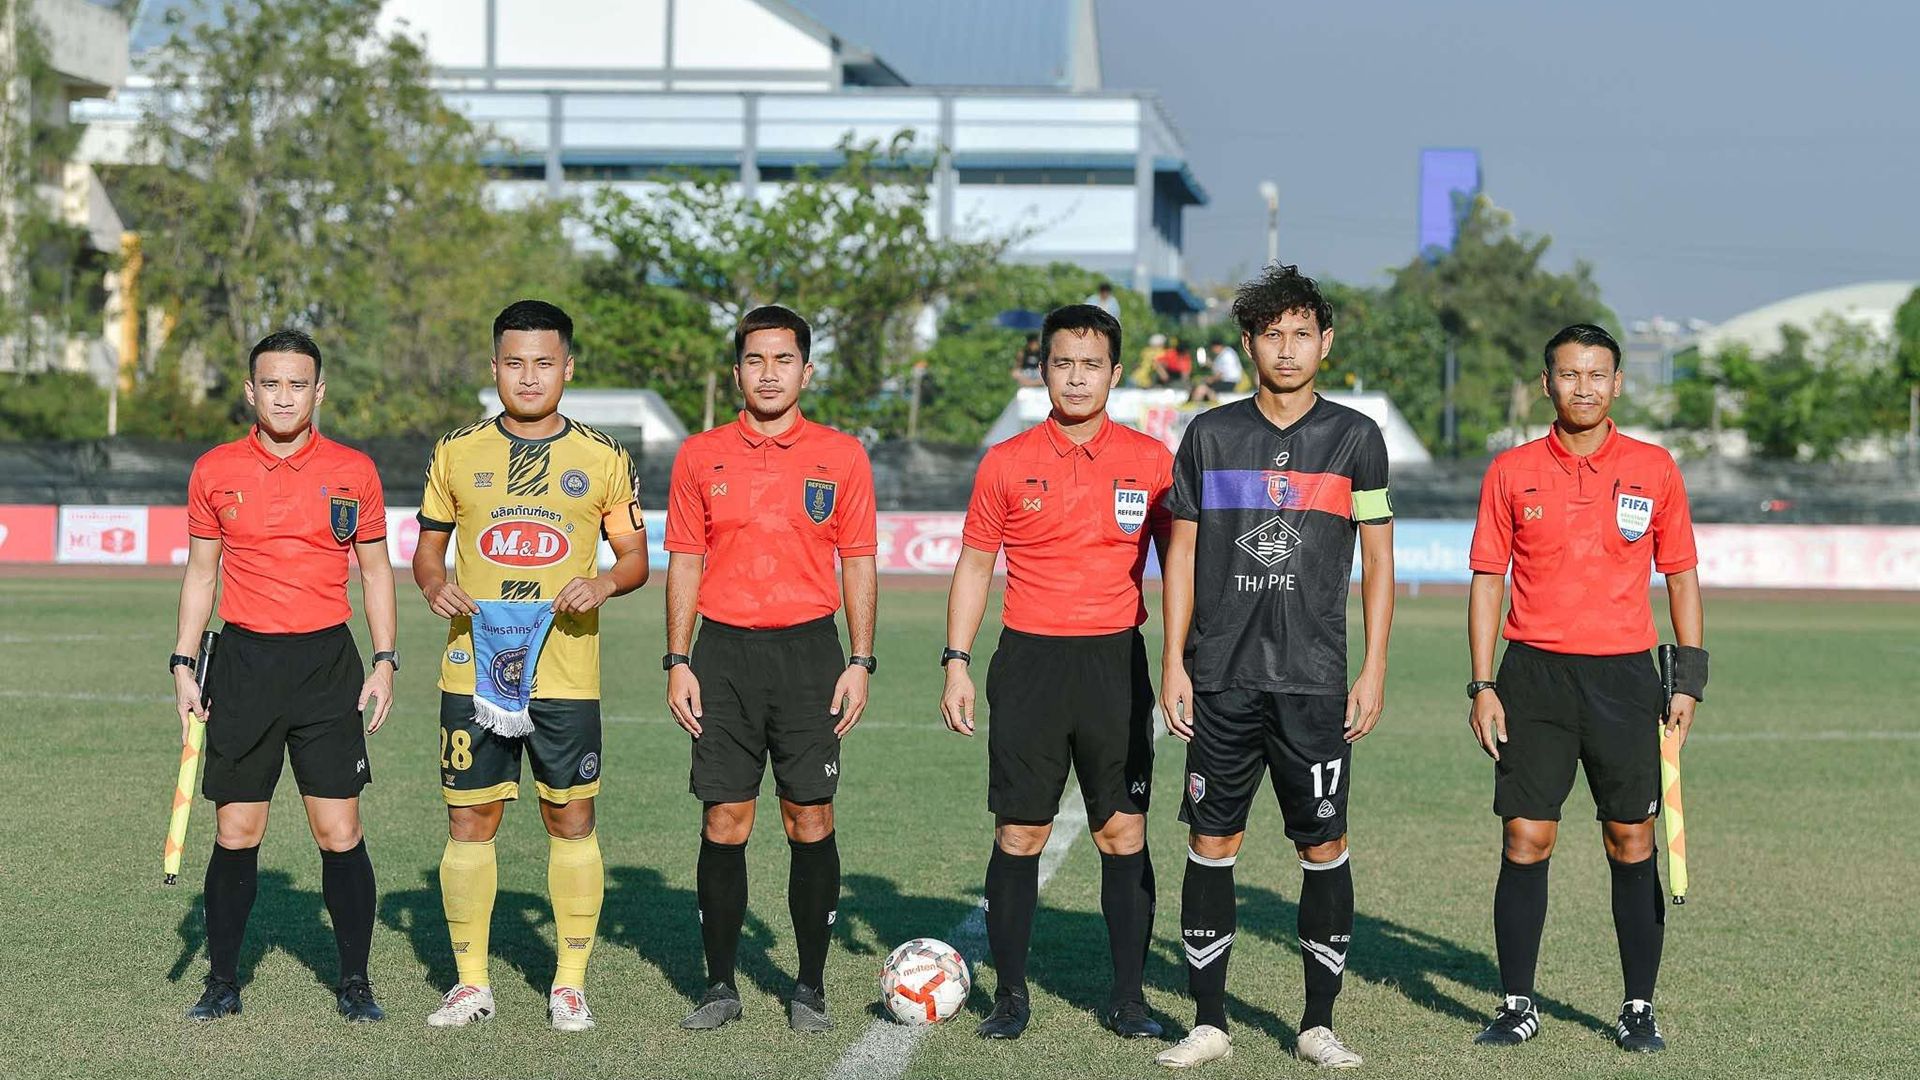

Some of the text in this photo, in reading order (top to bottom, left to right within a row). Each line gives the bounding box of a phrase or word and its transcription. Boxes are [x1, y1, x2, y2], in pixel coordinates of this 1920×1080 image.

[808, 481, 833, 490] REFEREE
[1118, 491, 1145, 504] FIFA
[1621, 497, 1649, 512] FIFA
[491, 504, 562, 522] ผลิตภัณฑ์ตรา
[628, 500, 644, 531] C
[1117, 509, 1144, 517] REFEREE
[489, 530, 560, 558] M&D
[1310, 758, 1342, 798] 17
[1184, 929, 1216, 938] EGO
[903, 963, 937, 977] molten
